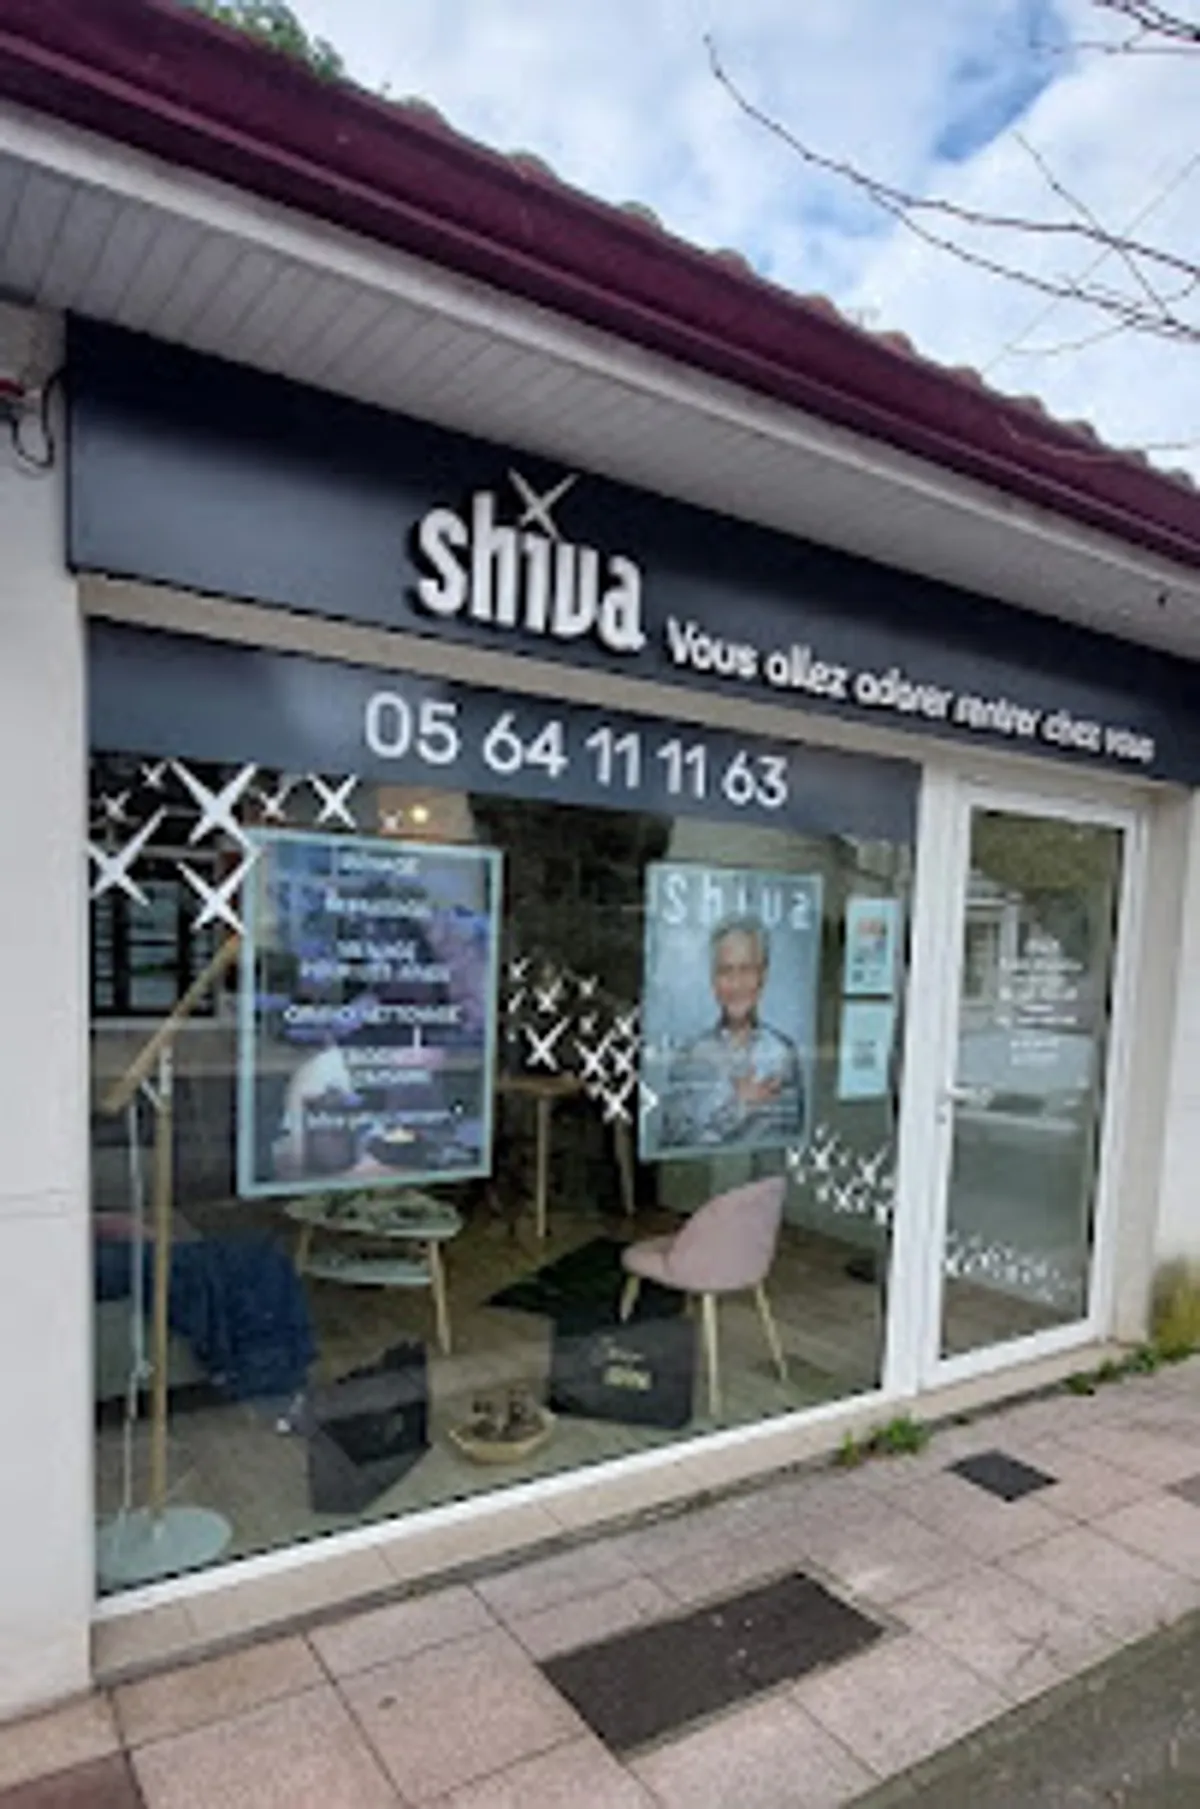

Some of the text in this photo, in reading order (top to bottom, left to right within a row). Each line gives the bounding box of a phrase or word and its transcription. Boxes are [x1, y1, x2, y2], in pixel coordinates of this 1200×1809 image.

[666, 616, 758, 679] Vous
[765, 644, 847, 699] allez
[364, 692, 789, 808] 05 64 11 11 63
